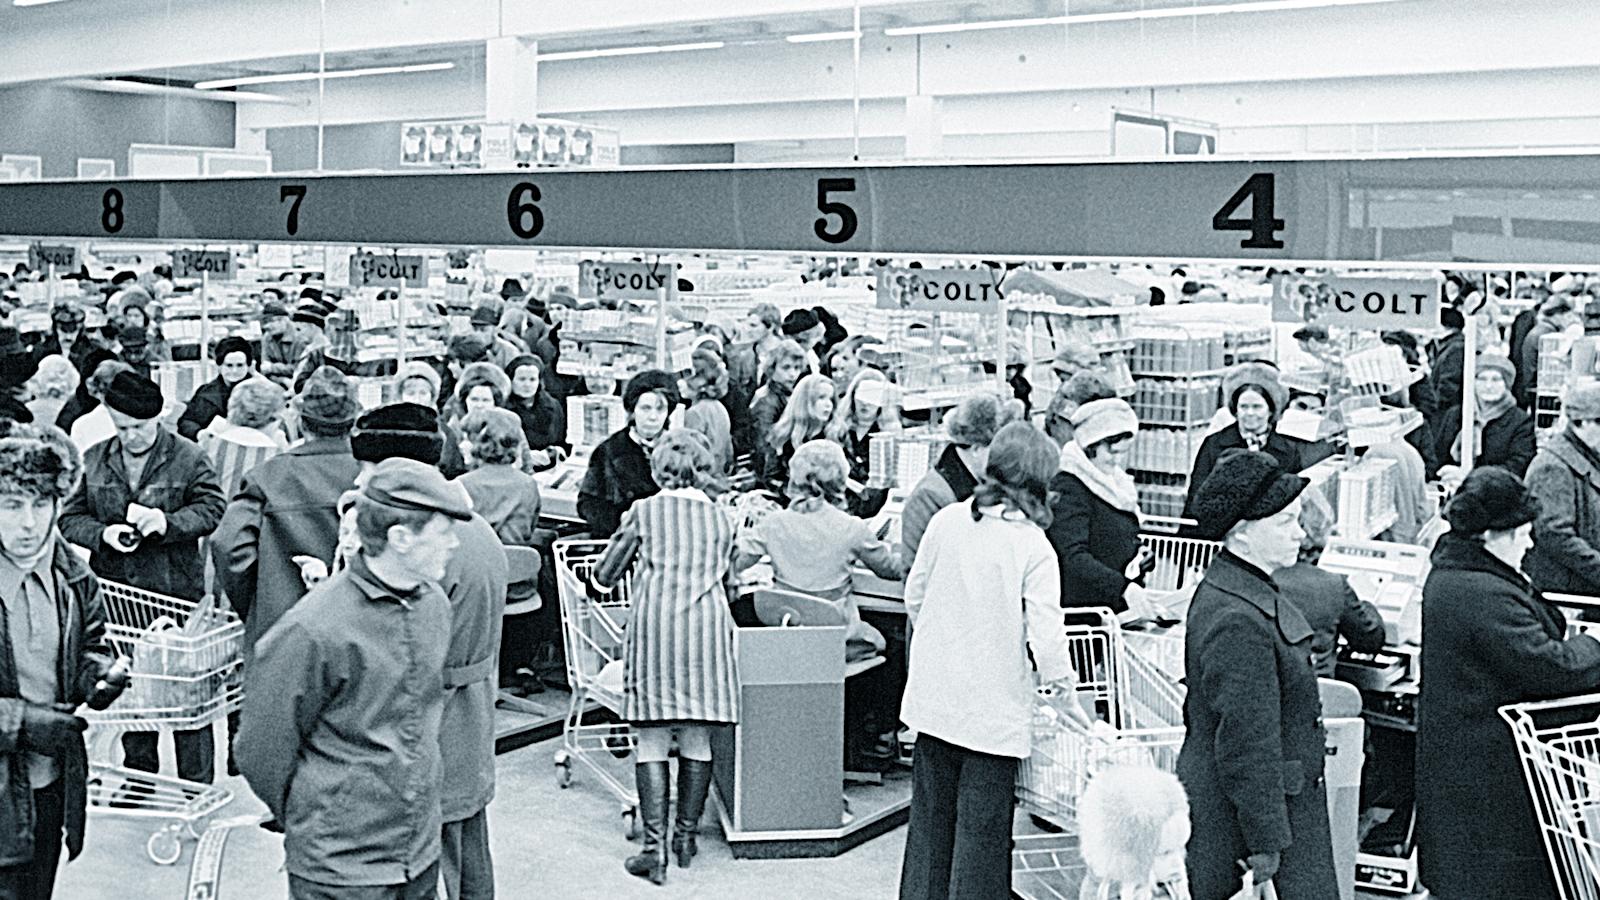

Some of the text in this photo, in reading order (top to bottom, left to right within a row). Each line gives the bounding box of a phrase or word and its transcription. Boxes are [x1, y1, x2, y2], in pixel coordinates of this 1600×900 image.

[102, 187, 124, 234] 8
[280, 185, 307, 236] 7
[507, 182, 544, 239] 6
[814, 178, 858, 243] 5
[1212, 173, 1285, 249] 4
[195, 258, 228, 273] COLT
[377, 264, 418, 279] COLT
[614, 273, 666, 290] COLT
[923, 281, 991, 301] COLT
[1335, 291, 1427, 314] COLT
